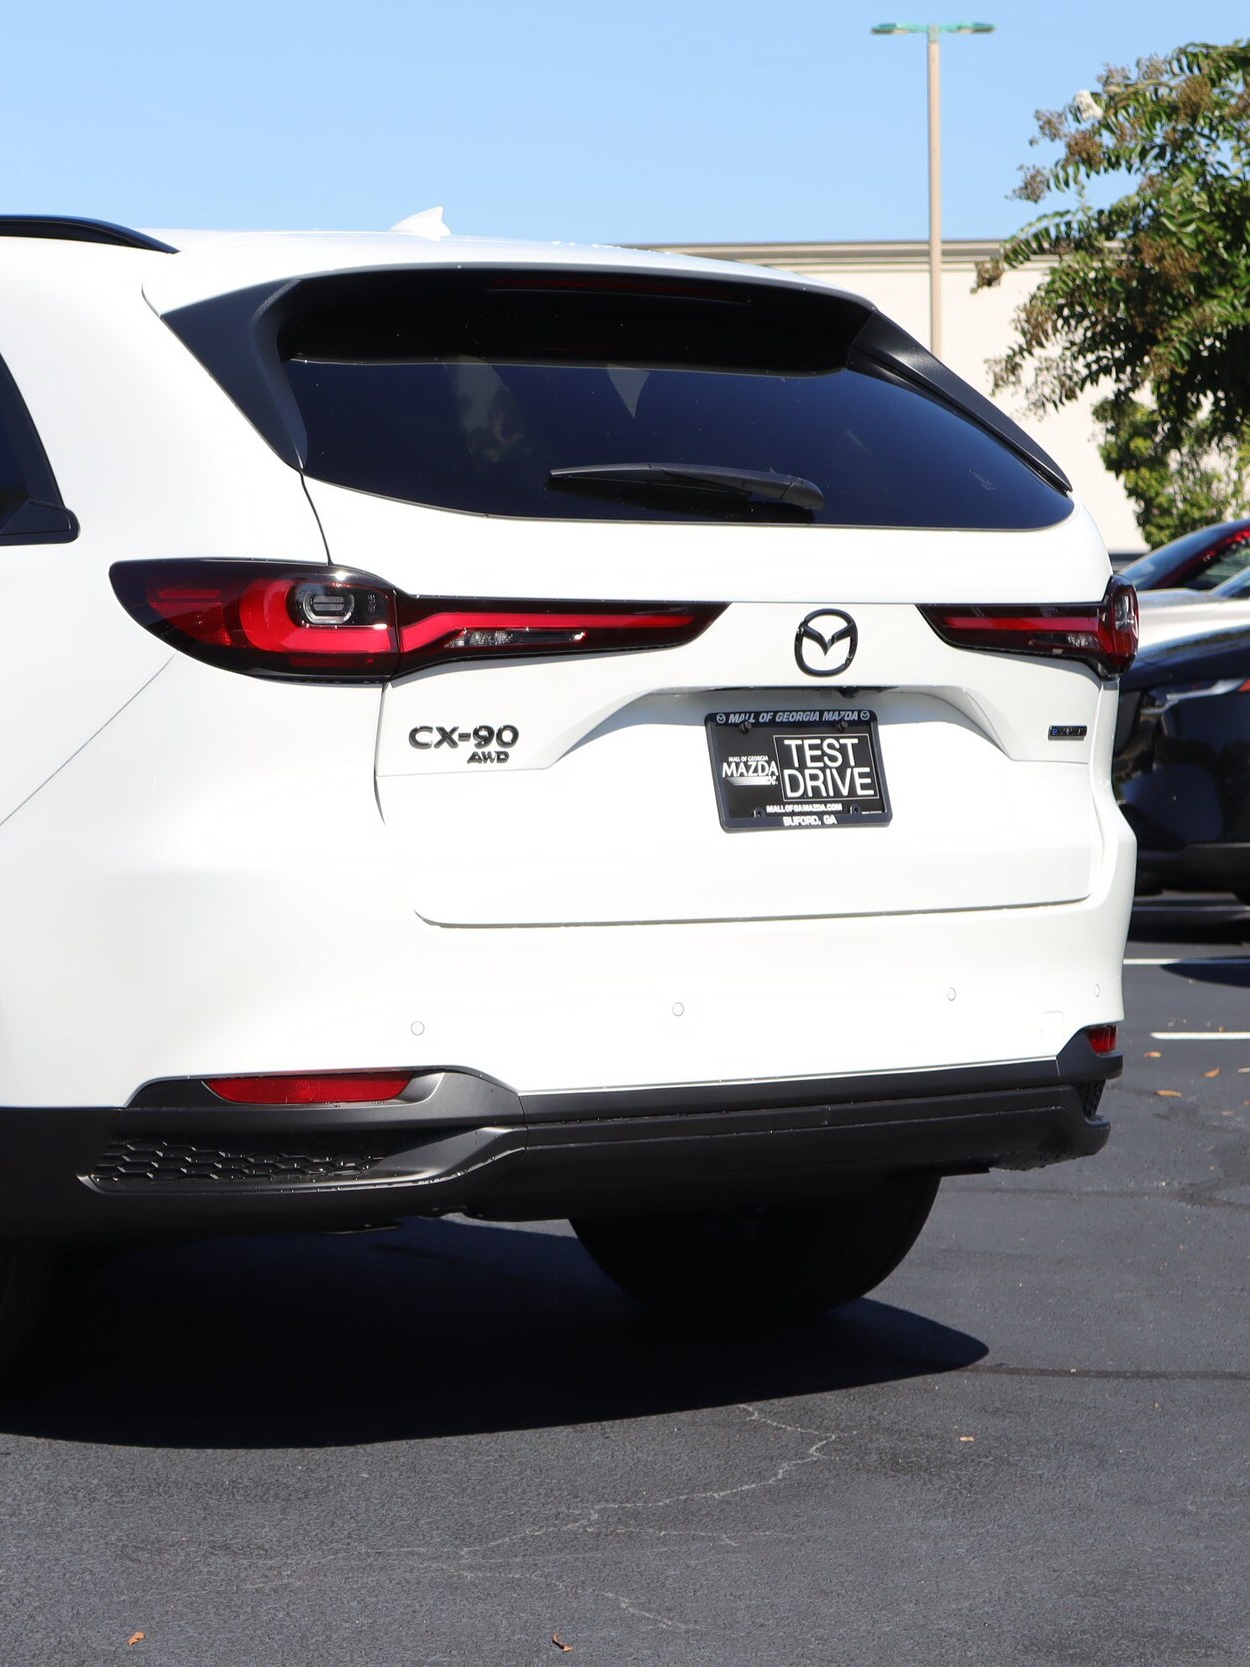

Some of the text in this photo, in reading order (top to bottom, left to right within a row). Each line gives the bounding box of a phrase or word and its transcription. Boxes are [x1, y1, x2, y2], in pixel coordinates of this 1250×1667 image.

[728, 710, 858, 724] MALL OF GEORGIA MAZDA
[408, 724, 520, 749] CX-90
[466, 750, 510, 764] AWD
[783, 738, 859, 768] TEST
[722, 760, 779, 778] MAZDA
[783, 767, 875, 798] DRIVE
[782, 814, 838, 827] BUFORD, GA
